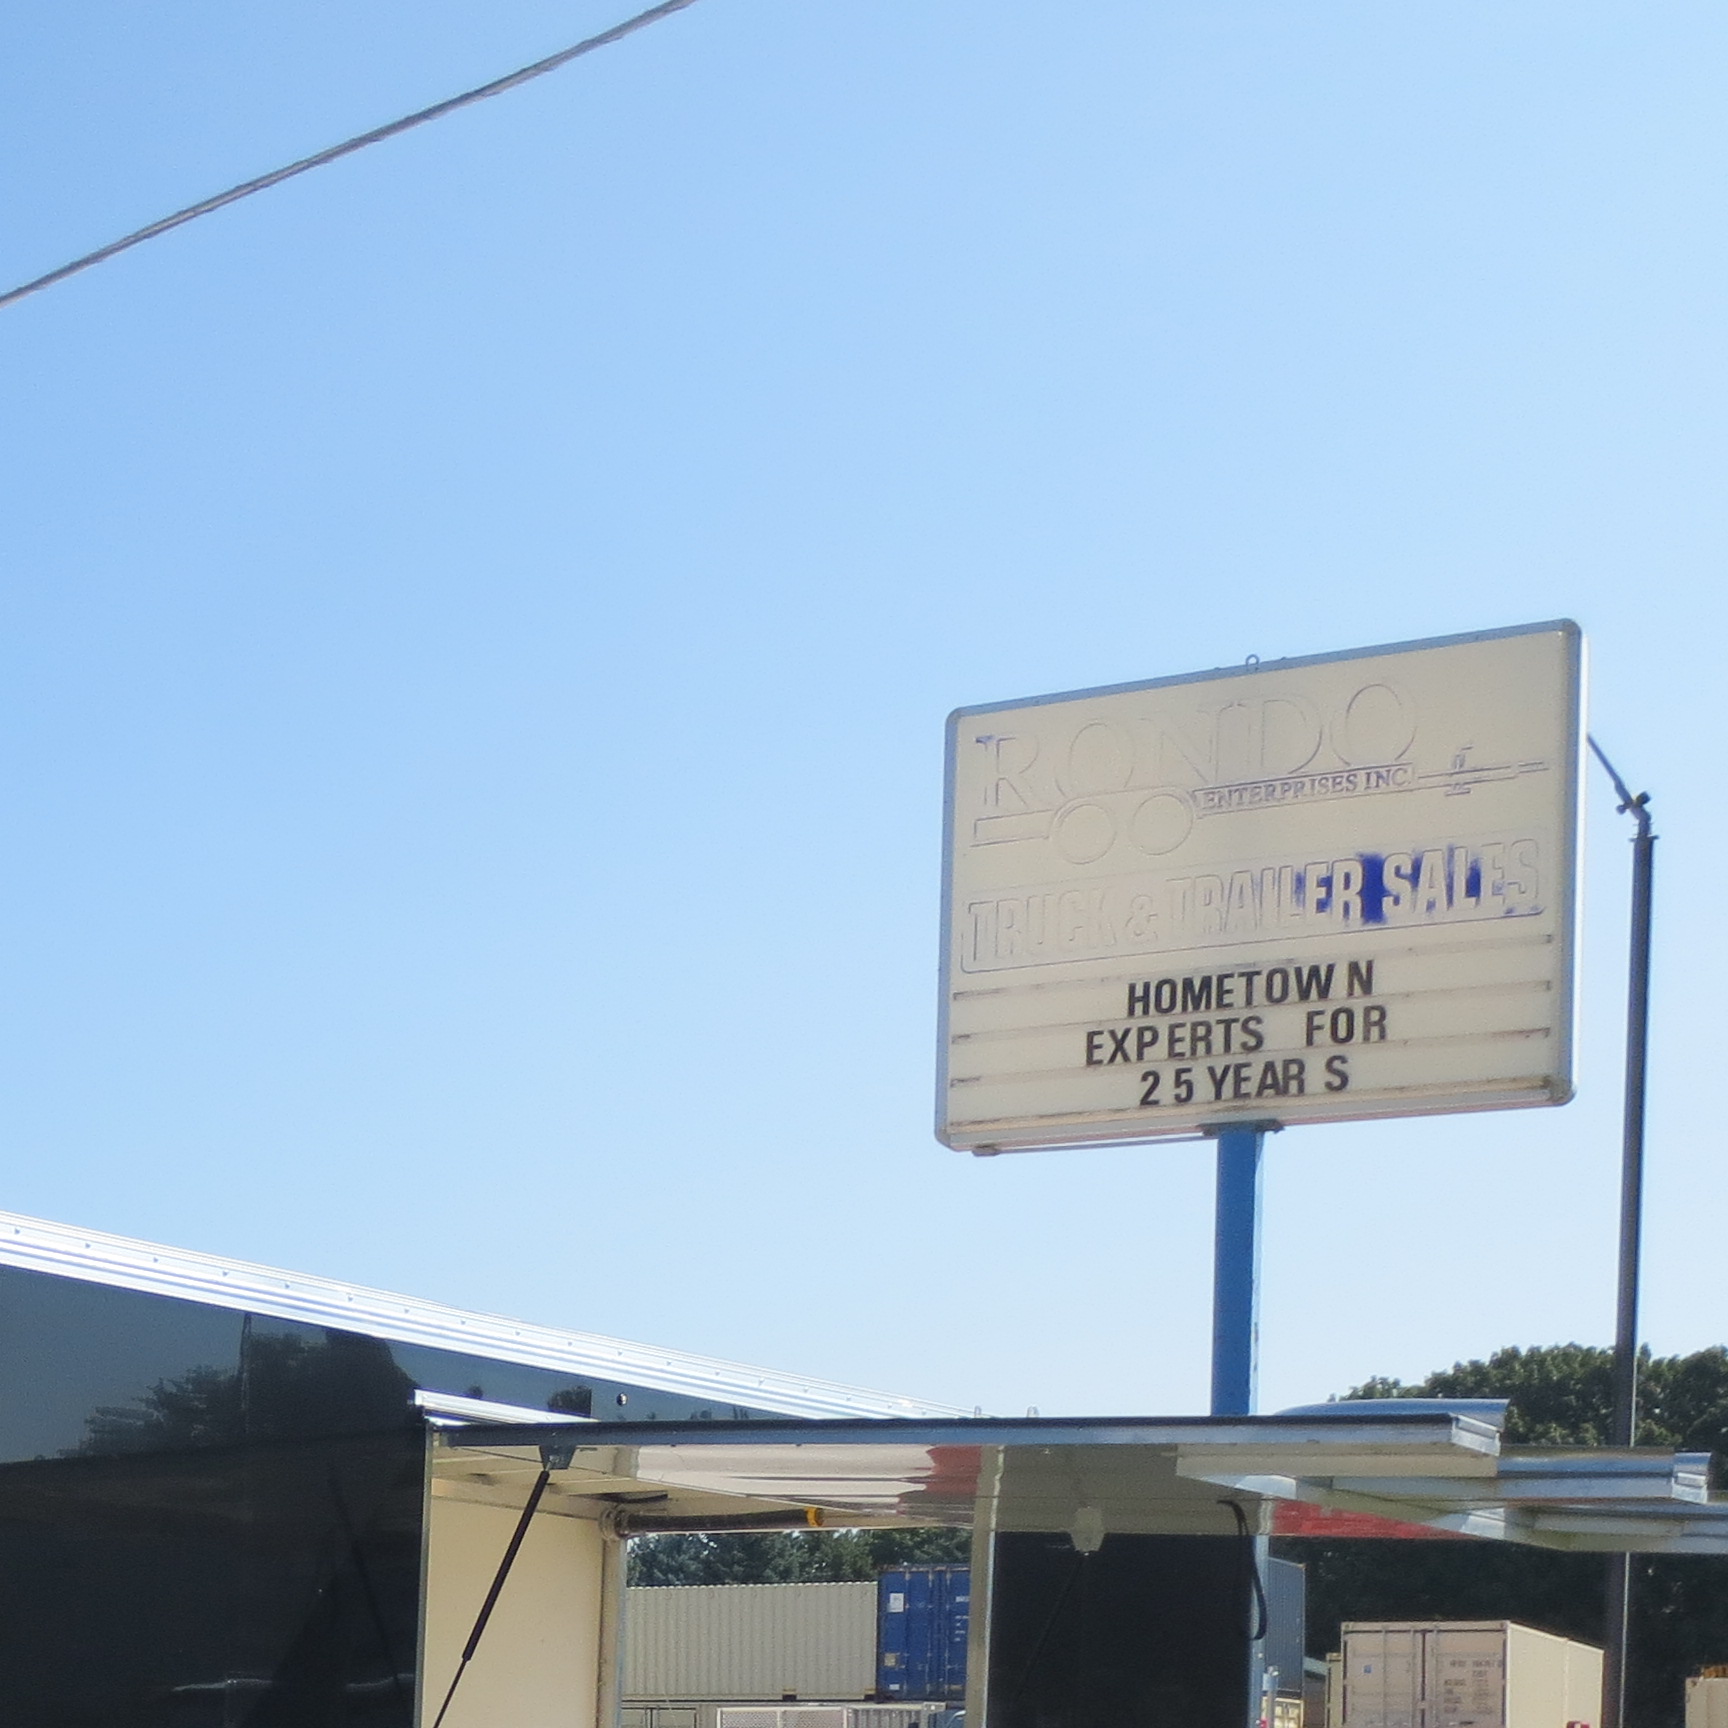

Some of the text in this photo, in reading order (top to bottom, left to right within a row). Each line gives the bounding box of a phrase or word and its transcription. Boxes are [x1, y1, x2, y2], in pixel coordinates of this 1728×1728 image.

[975, 684, 1417, 806] RONDO
[1199, 773, 1359, 811] ENTERPRISES
[1166, 858, 1365, 936] TRAILER
[1380, 838, 1541, 912] SALES
[1126, 959, 1374, 1018] HOMETOWN
[1085, 1004, 1388, 1067] EXPERTS FOR
[1139, 1054, 1350, 1107] 25 YEARS
